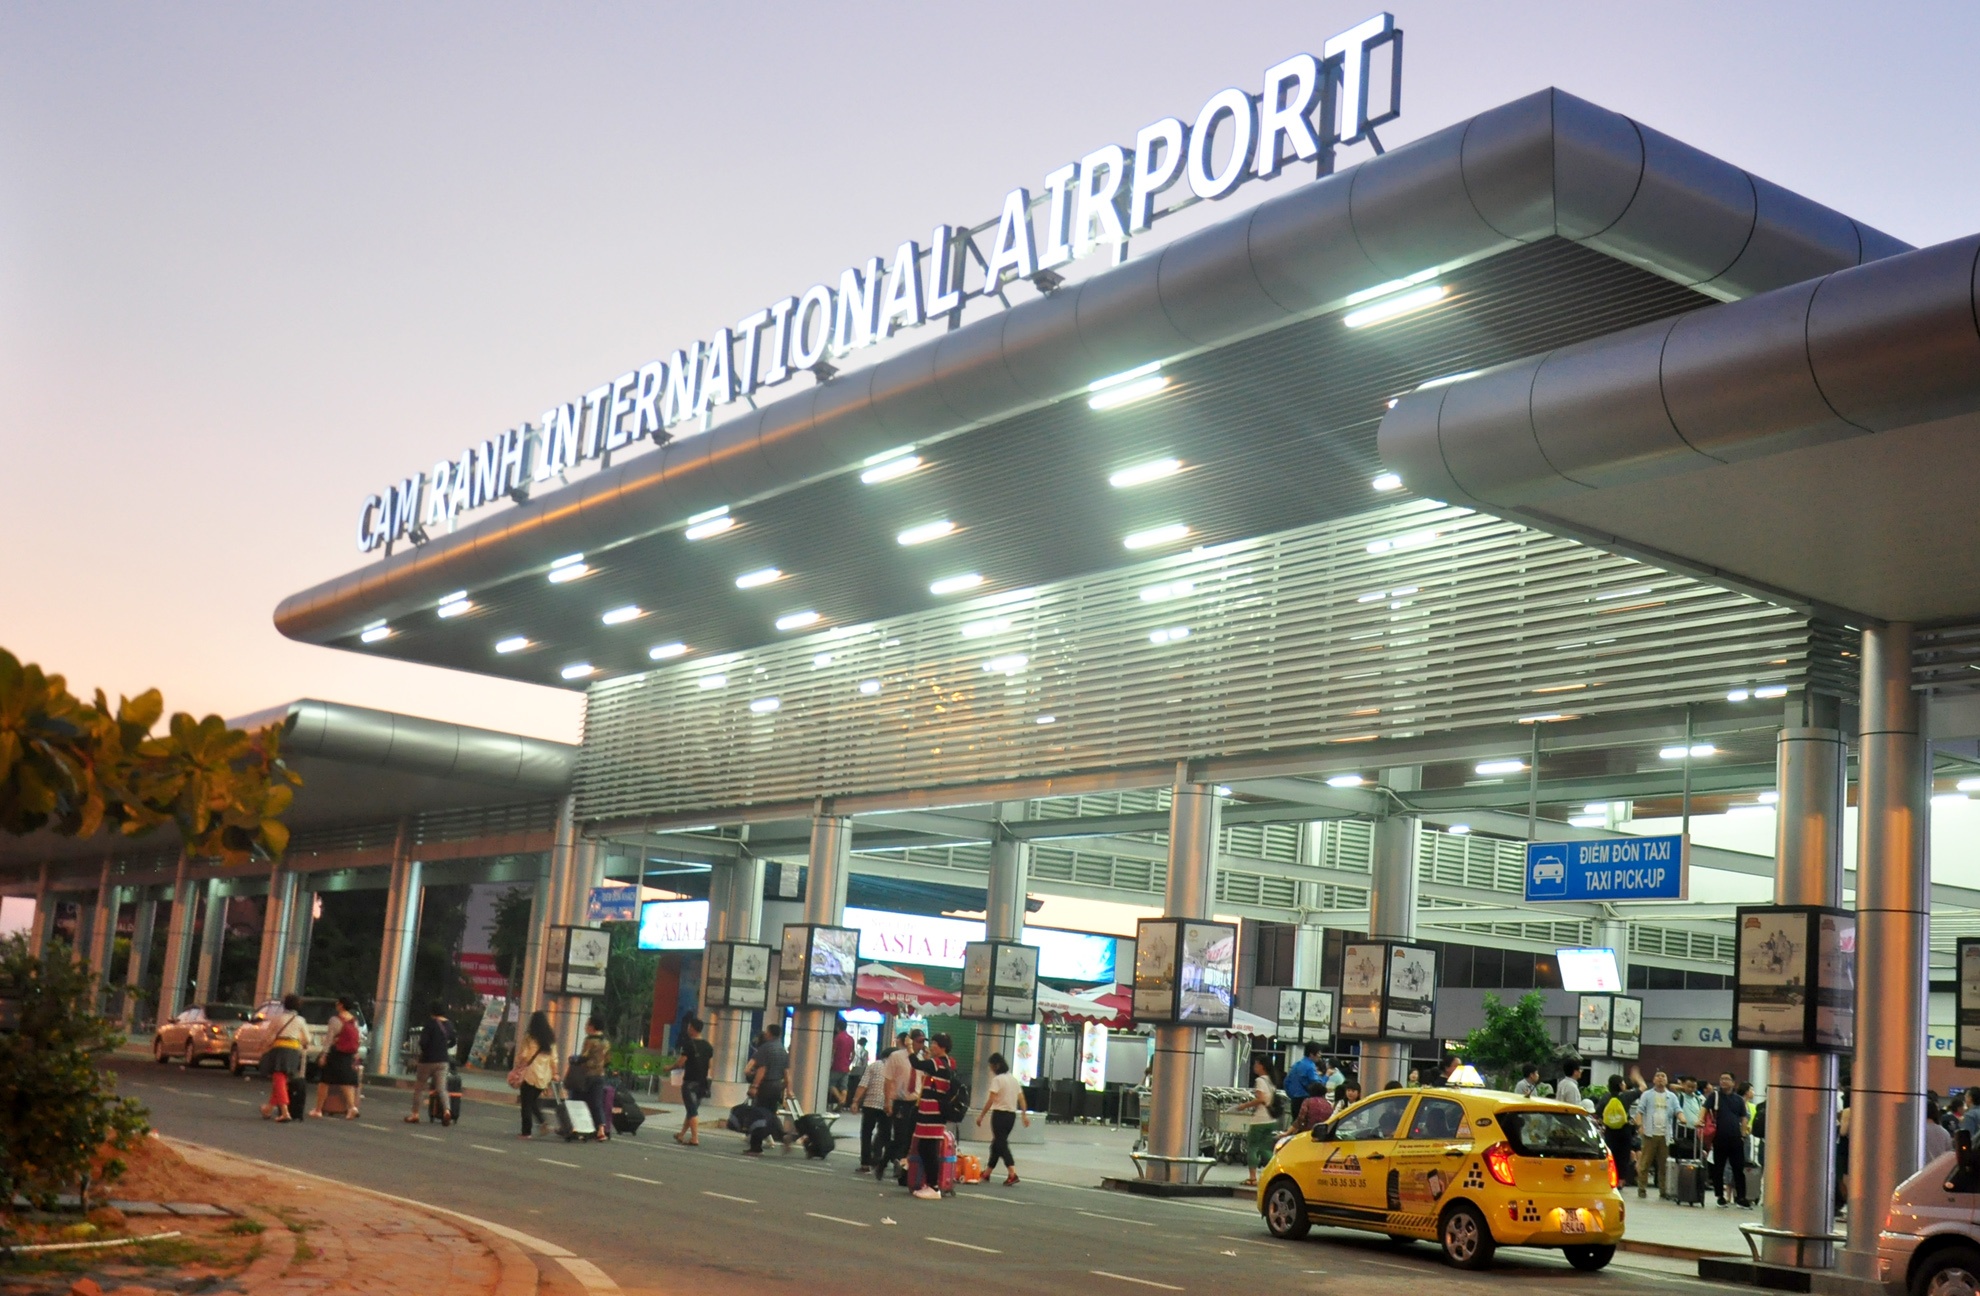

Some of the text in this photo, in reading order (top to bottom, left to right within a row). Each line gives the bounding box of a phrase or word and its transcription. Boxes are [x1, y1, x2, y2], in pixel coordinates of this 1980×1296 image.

[357, 11, 1394, 552] CAM RANH INTERNATIONAL AIRPORT
[1612, 841, 1640, 862] ĐÓN
[1643, 841, 1671, 861] TAXI
[1585, 868, 1665, 890] TAXI PICK-UP
[661, 922, 690, 941] ASIA
[873, 932, 932, 956] ASIA
[1699, 1027, 1723, 1042] GA
